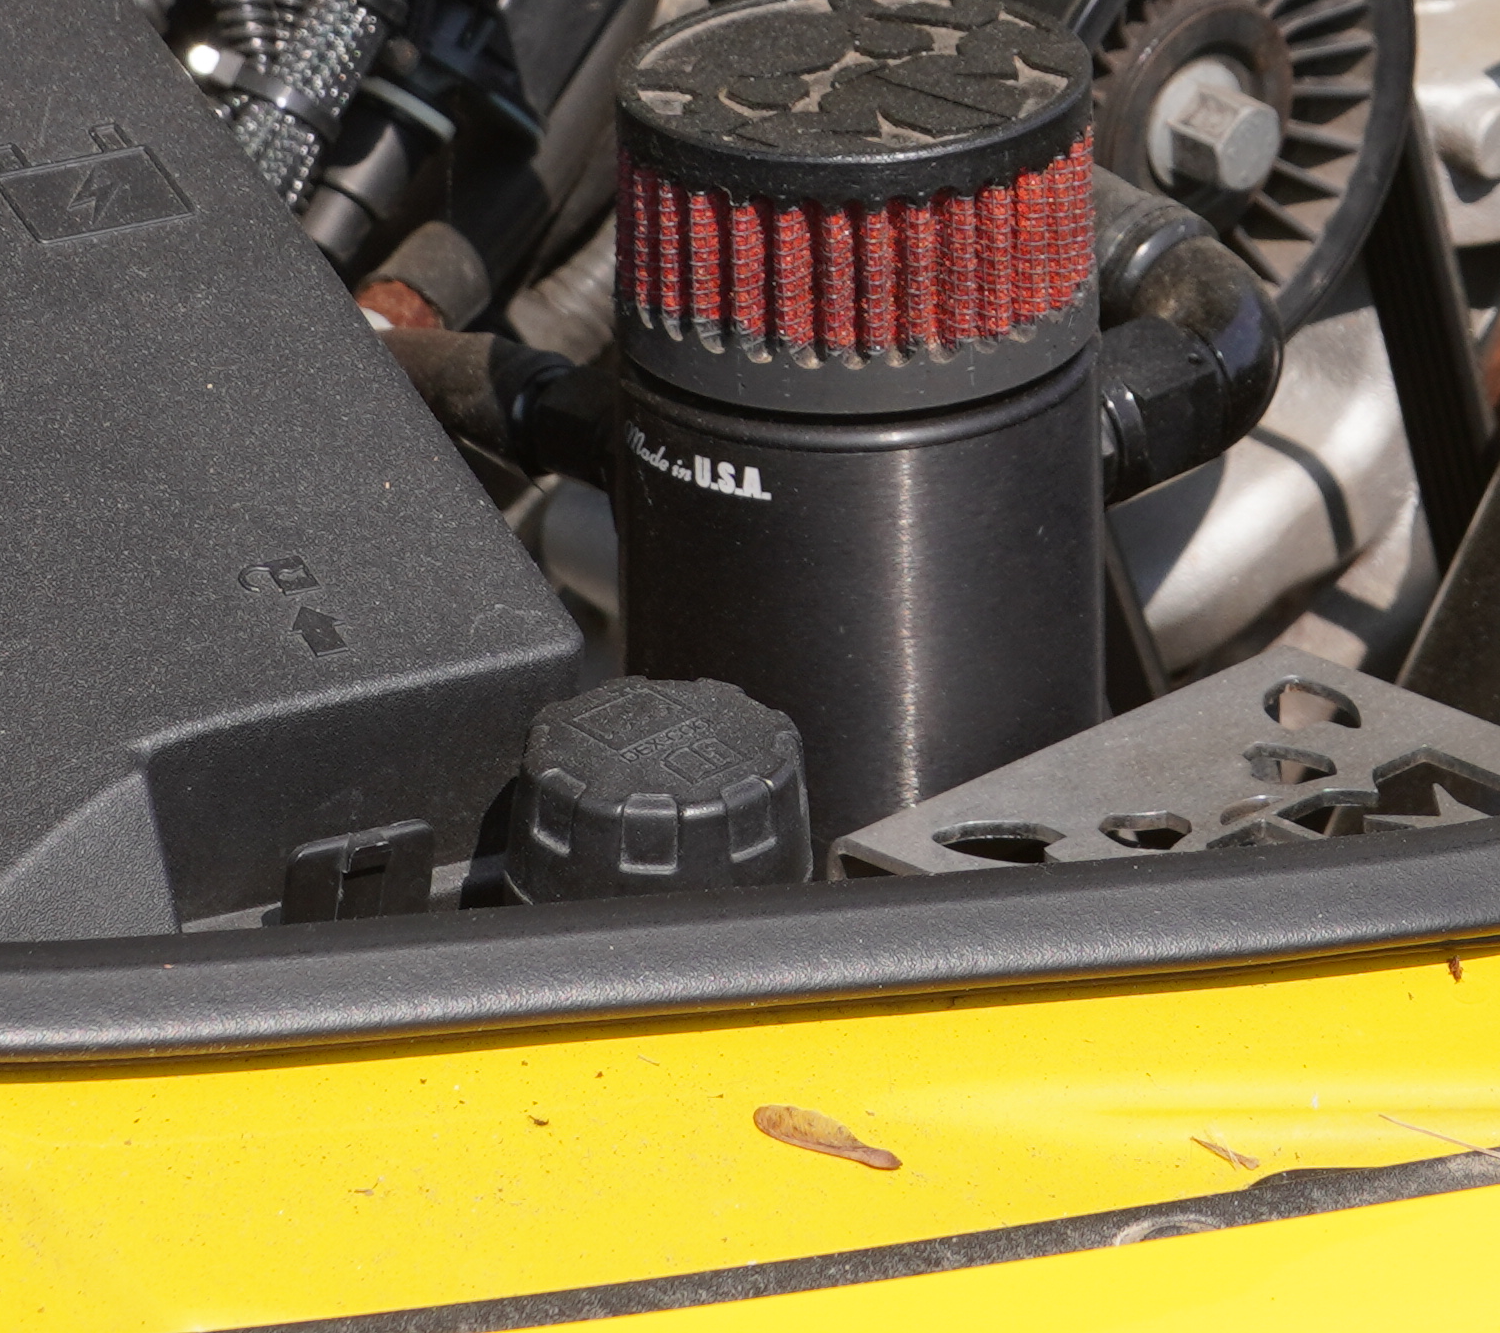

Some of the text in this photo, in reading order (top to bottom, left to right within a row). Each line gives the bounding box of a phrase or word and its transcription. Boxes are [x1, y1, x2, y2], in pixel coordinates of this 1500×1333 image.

[625, 420, 772, 501] Made in U.S.A.
